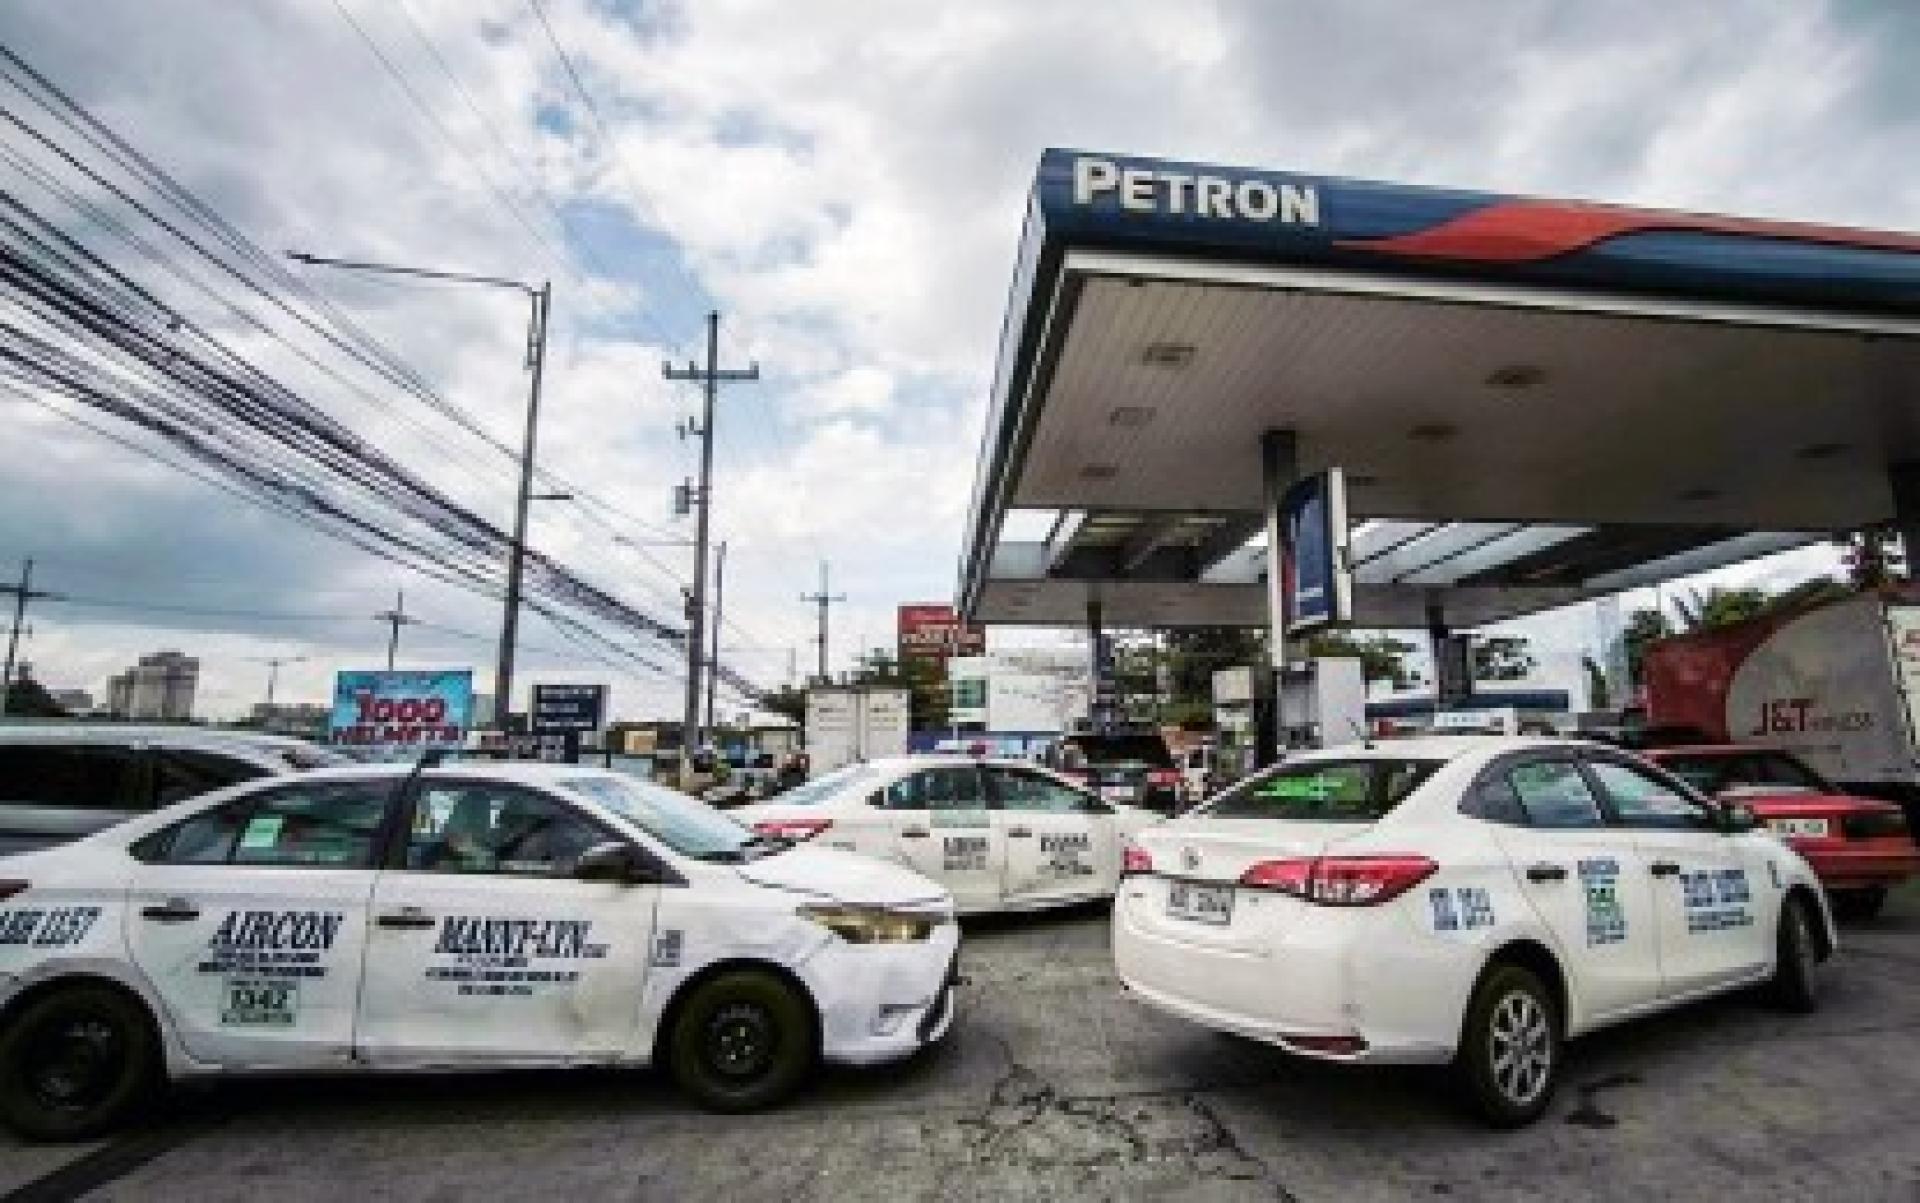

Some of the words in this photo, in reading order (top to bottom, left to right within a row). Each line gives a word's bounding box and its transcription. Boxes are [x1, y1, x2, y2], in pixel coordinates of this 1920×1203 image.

[1073, 156, 1319, 227] PETRON
[1752, 697, 1812, 736] J&T
[209, 910, 347, 950] AIRCON
